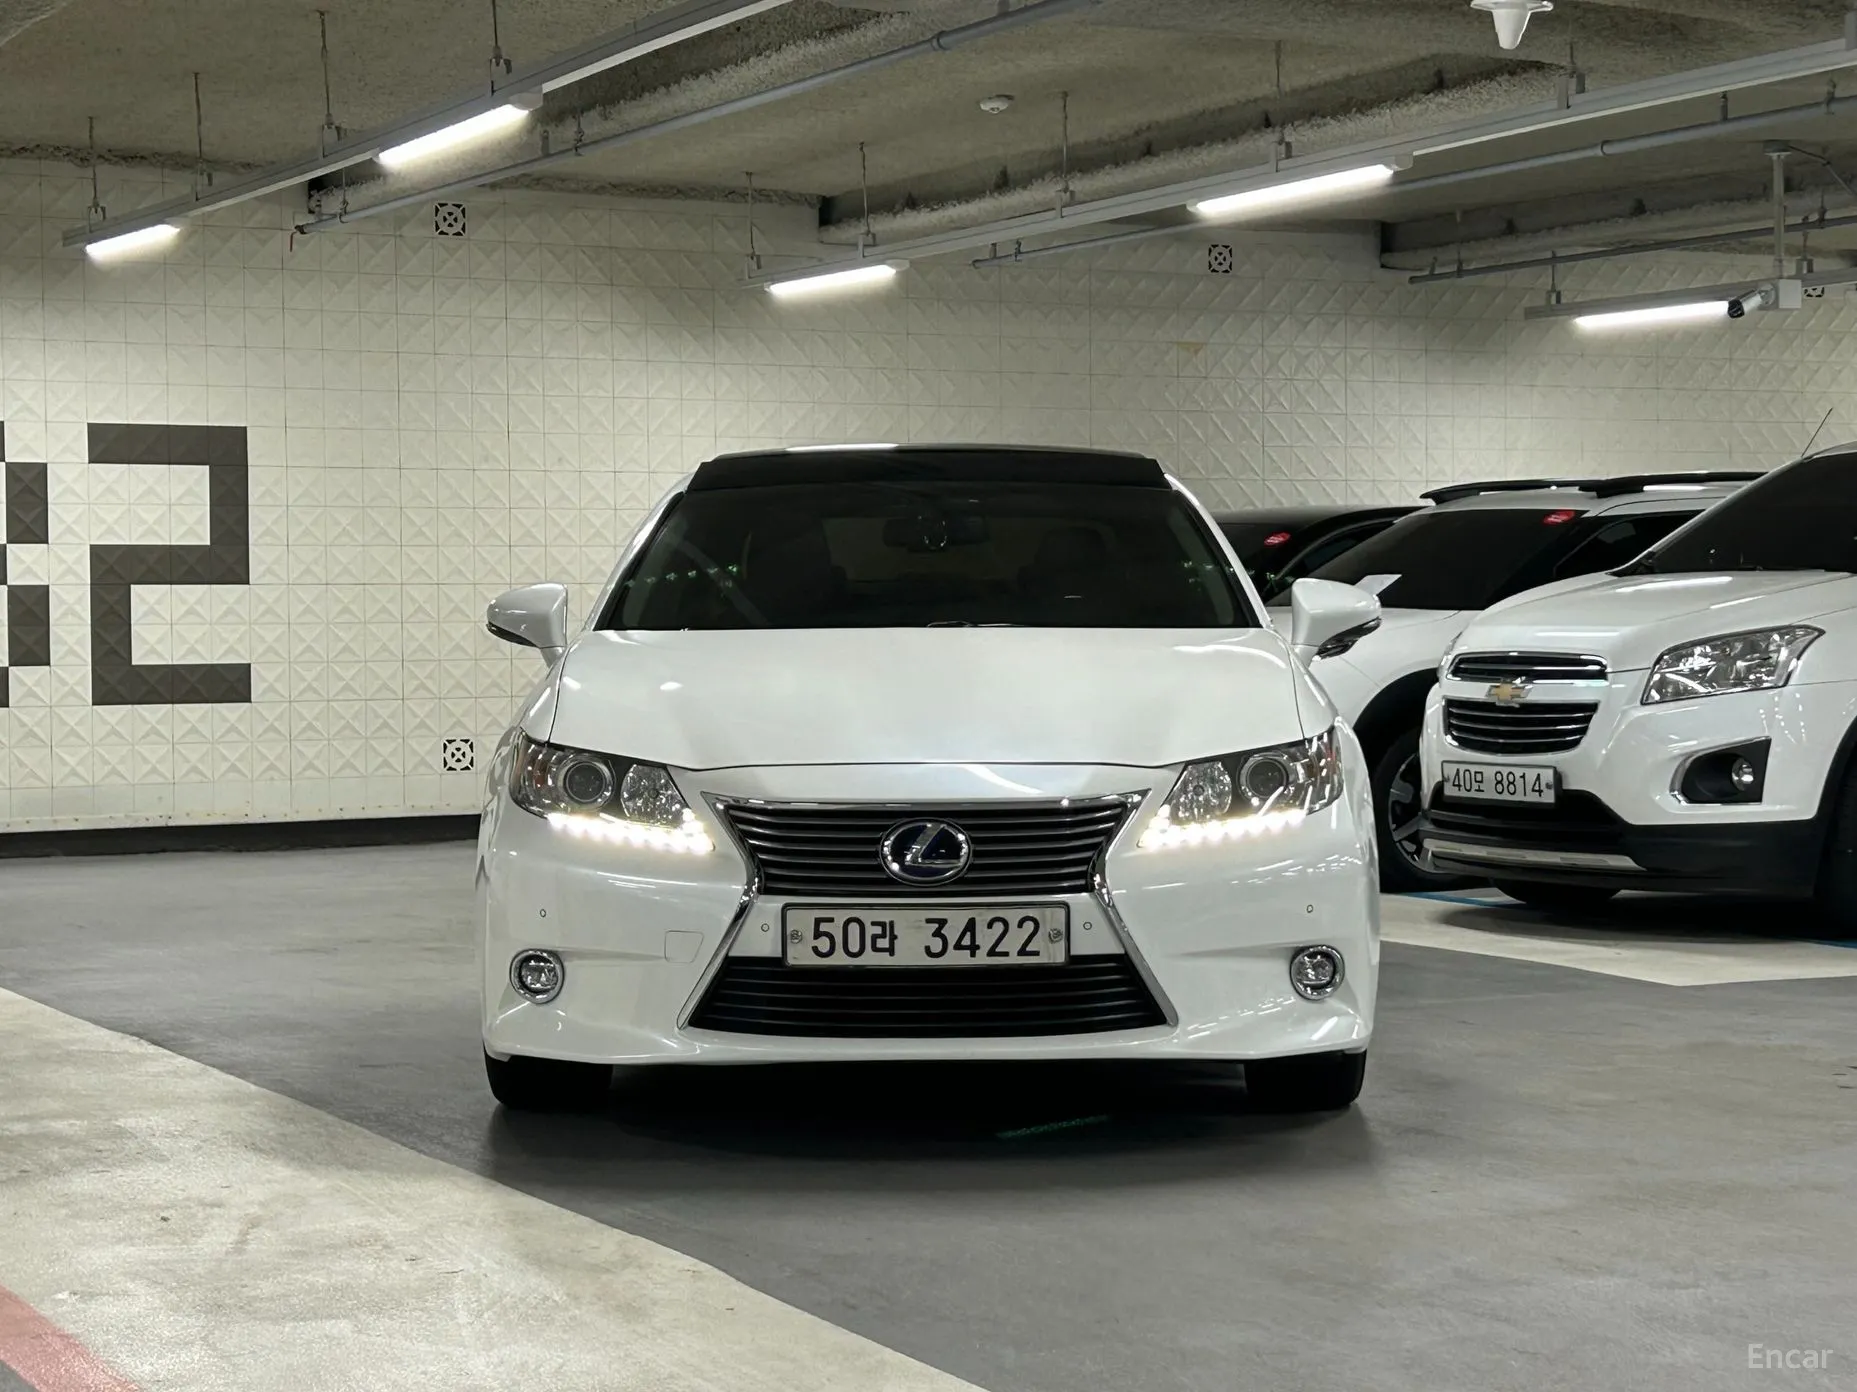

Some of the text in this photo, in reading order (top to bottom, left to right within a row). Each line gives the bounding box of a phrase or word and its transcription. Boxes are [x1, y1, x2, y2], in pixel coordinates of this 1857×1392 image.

[1452, 768, 1544, 798] 40모 8814
[811, 915, 1042, 959] 50라 3422
